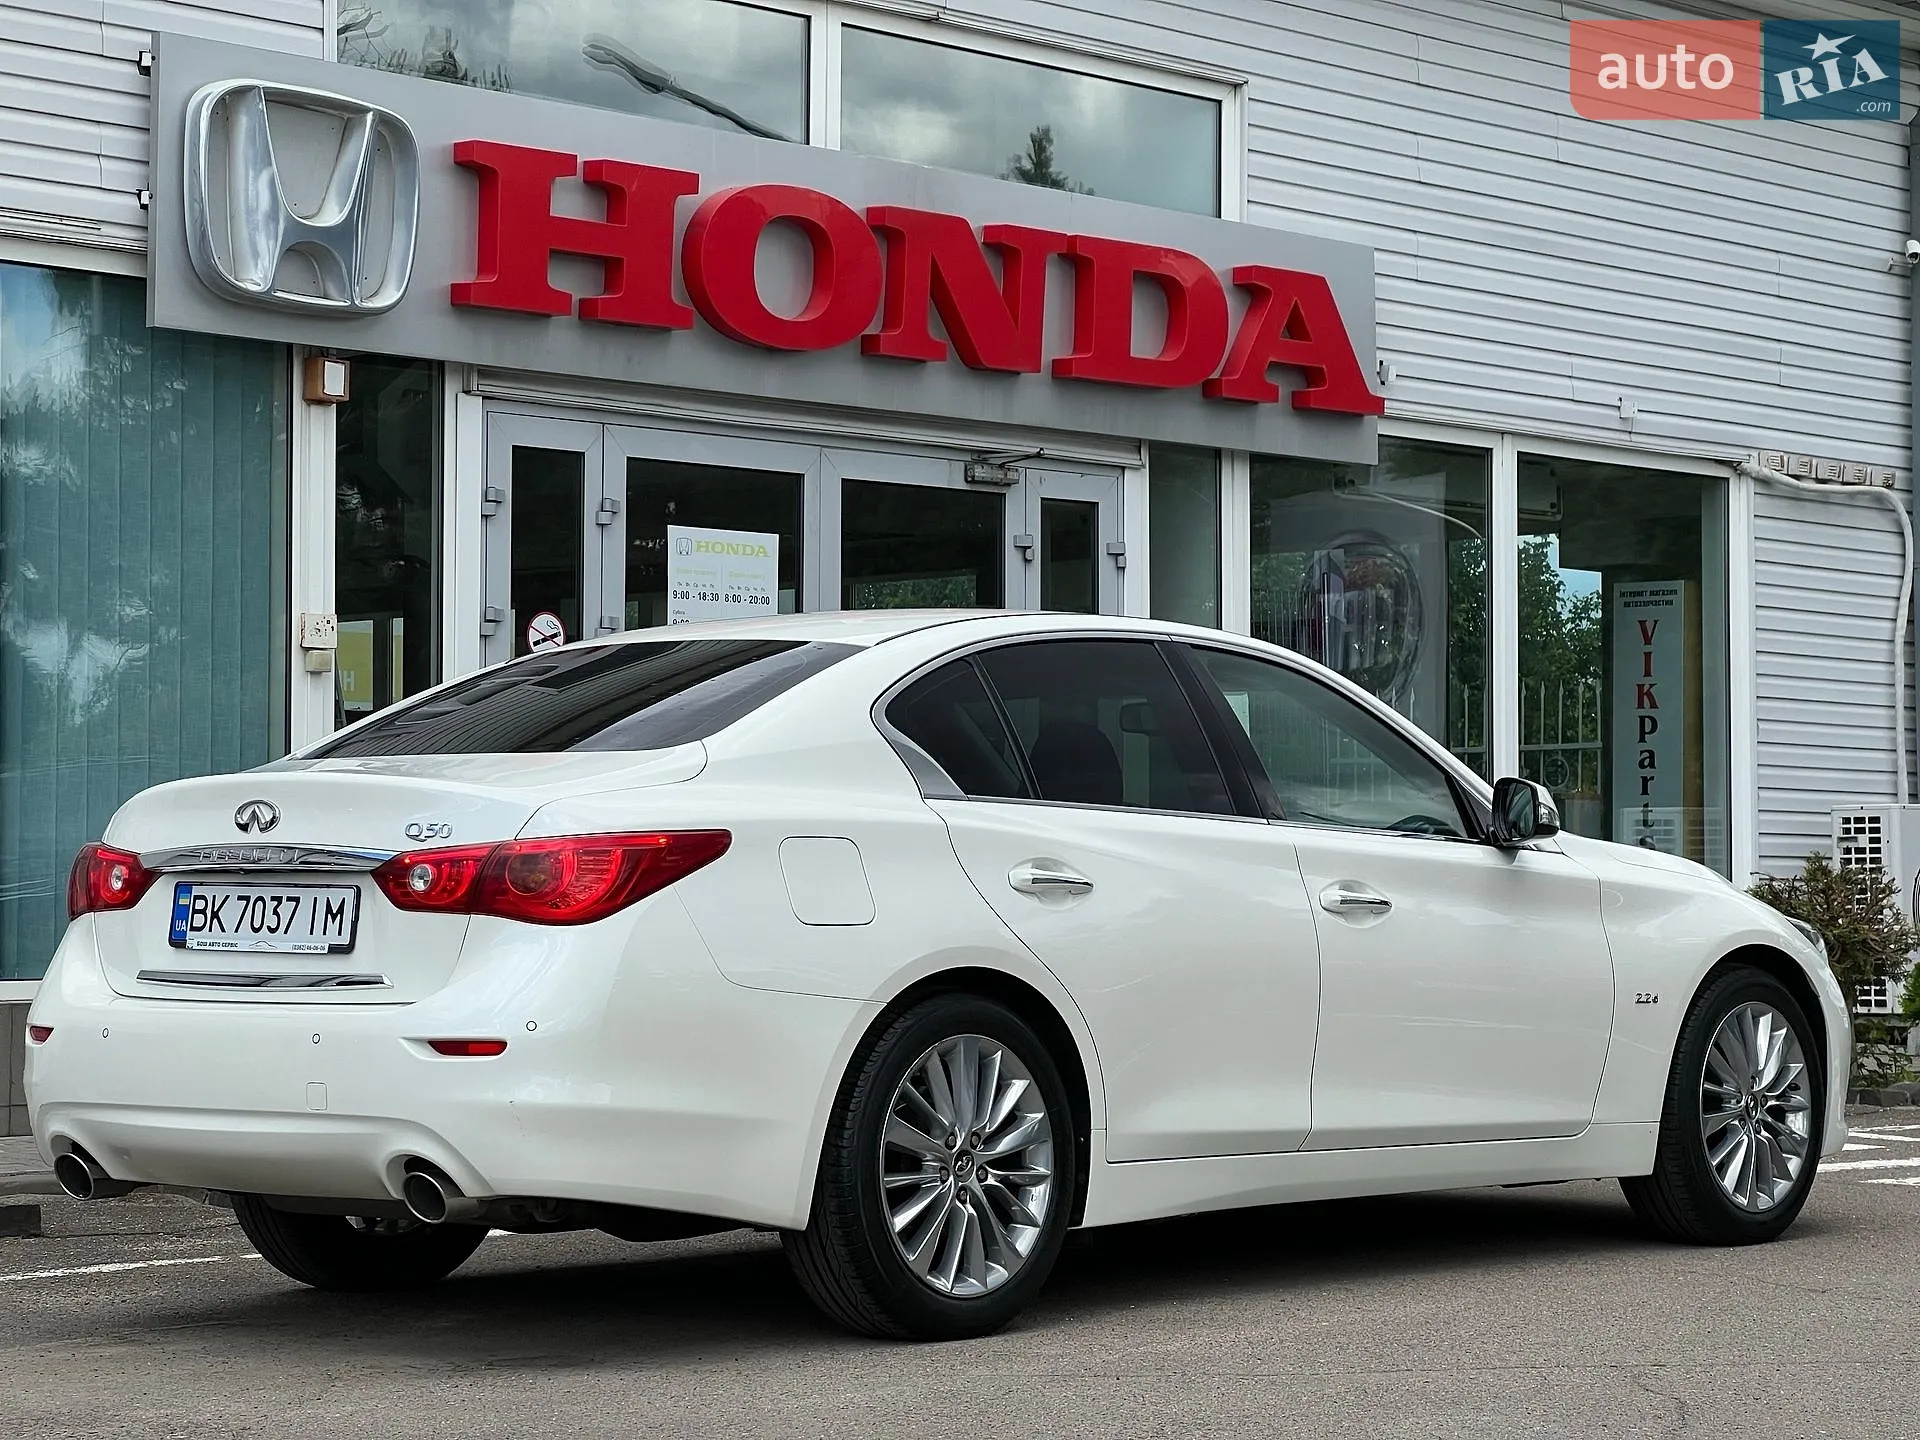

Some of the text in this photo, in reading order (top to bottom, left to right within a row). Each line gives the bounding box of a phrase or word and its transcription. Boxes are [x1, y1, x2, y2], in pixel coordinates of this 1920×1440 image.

[451, 139, 1386, 417] HONDA
[694, 540, 771, 558] HONDA
[672, 589, 690, 600] 9:00
[697, 591, 720, 602] 18:30
[724, 593, 742, 604] 8:00
[748, 595, 770, 606] 20:00
[404, 821, 454, 843] Q50
[189, 894, 346, 937] BK 7037 IM
[175, 920, 187, 932] UA
